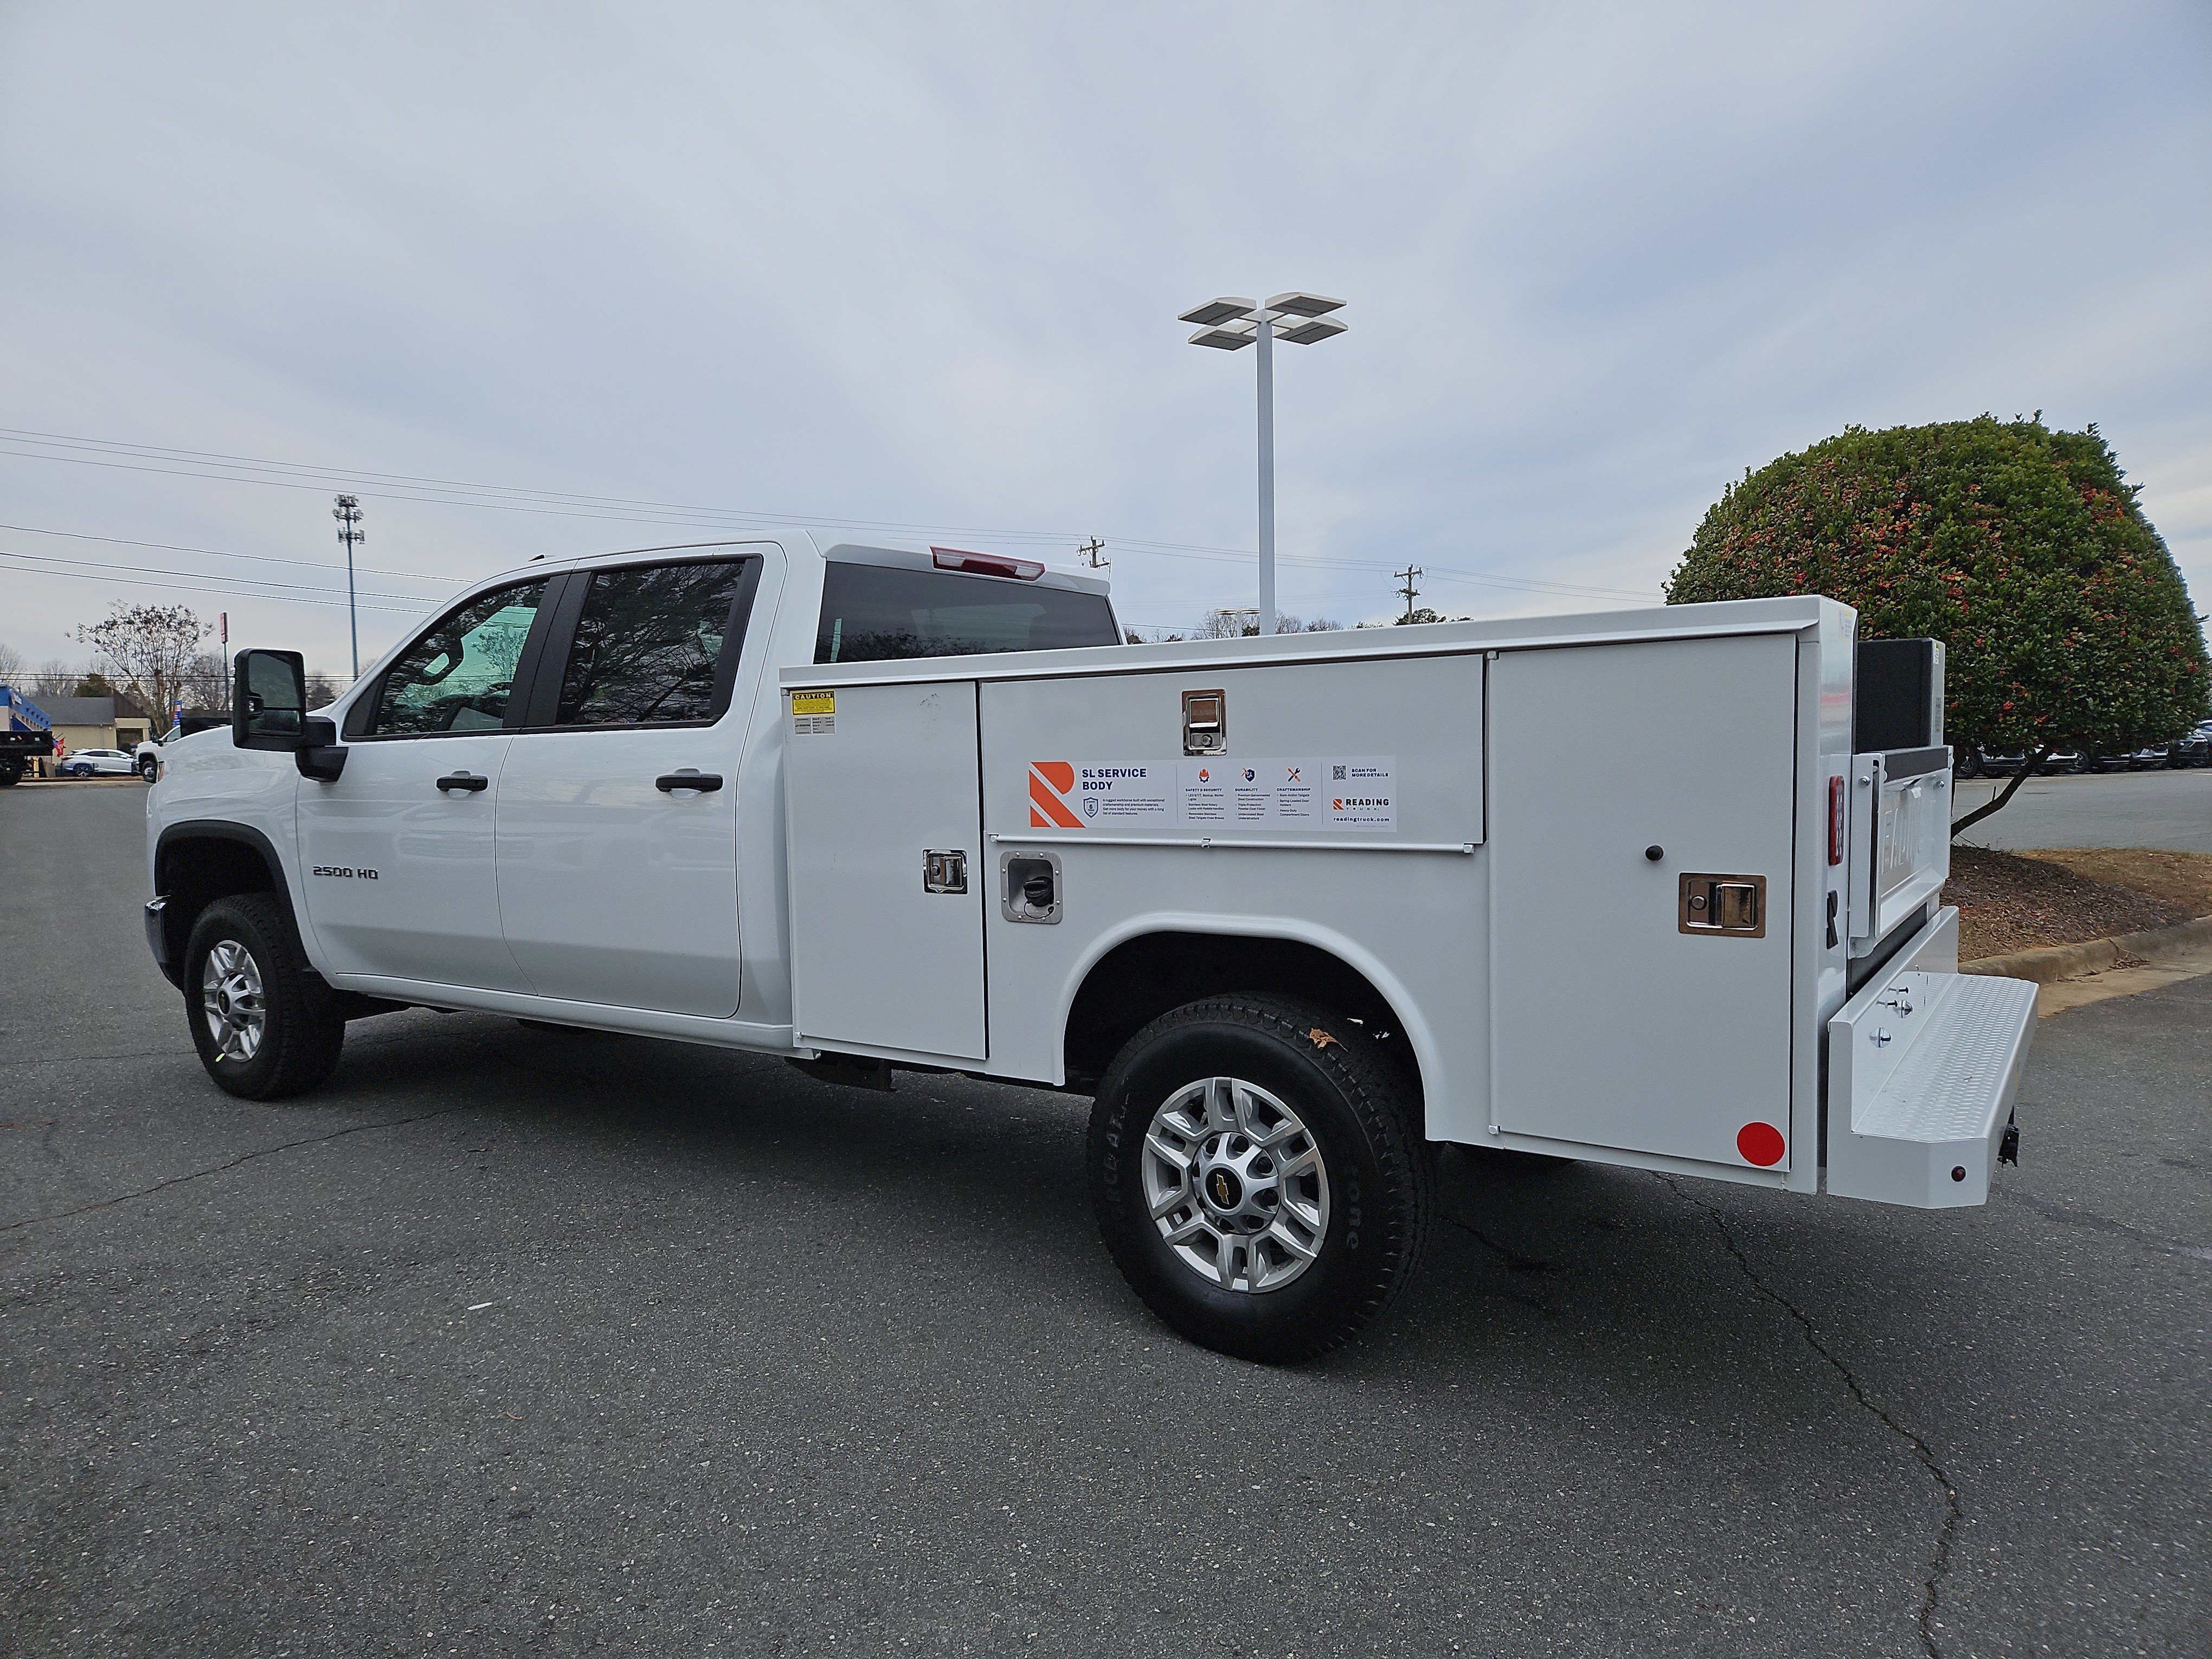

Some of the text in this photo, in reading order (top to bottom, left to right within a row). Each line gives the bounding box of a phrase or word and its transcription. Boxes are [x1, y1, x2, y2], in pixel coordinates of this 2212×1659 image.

[1082, 768, 1147, 778] SL SERVICE
[1082, 781, 1113, 790] BODY
[313, 866, 378, 879] 2500 HD
